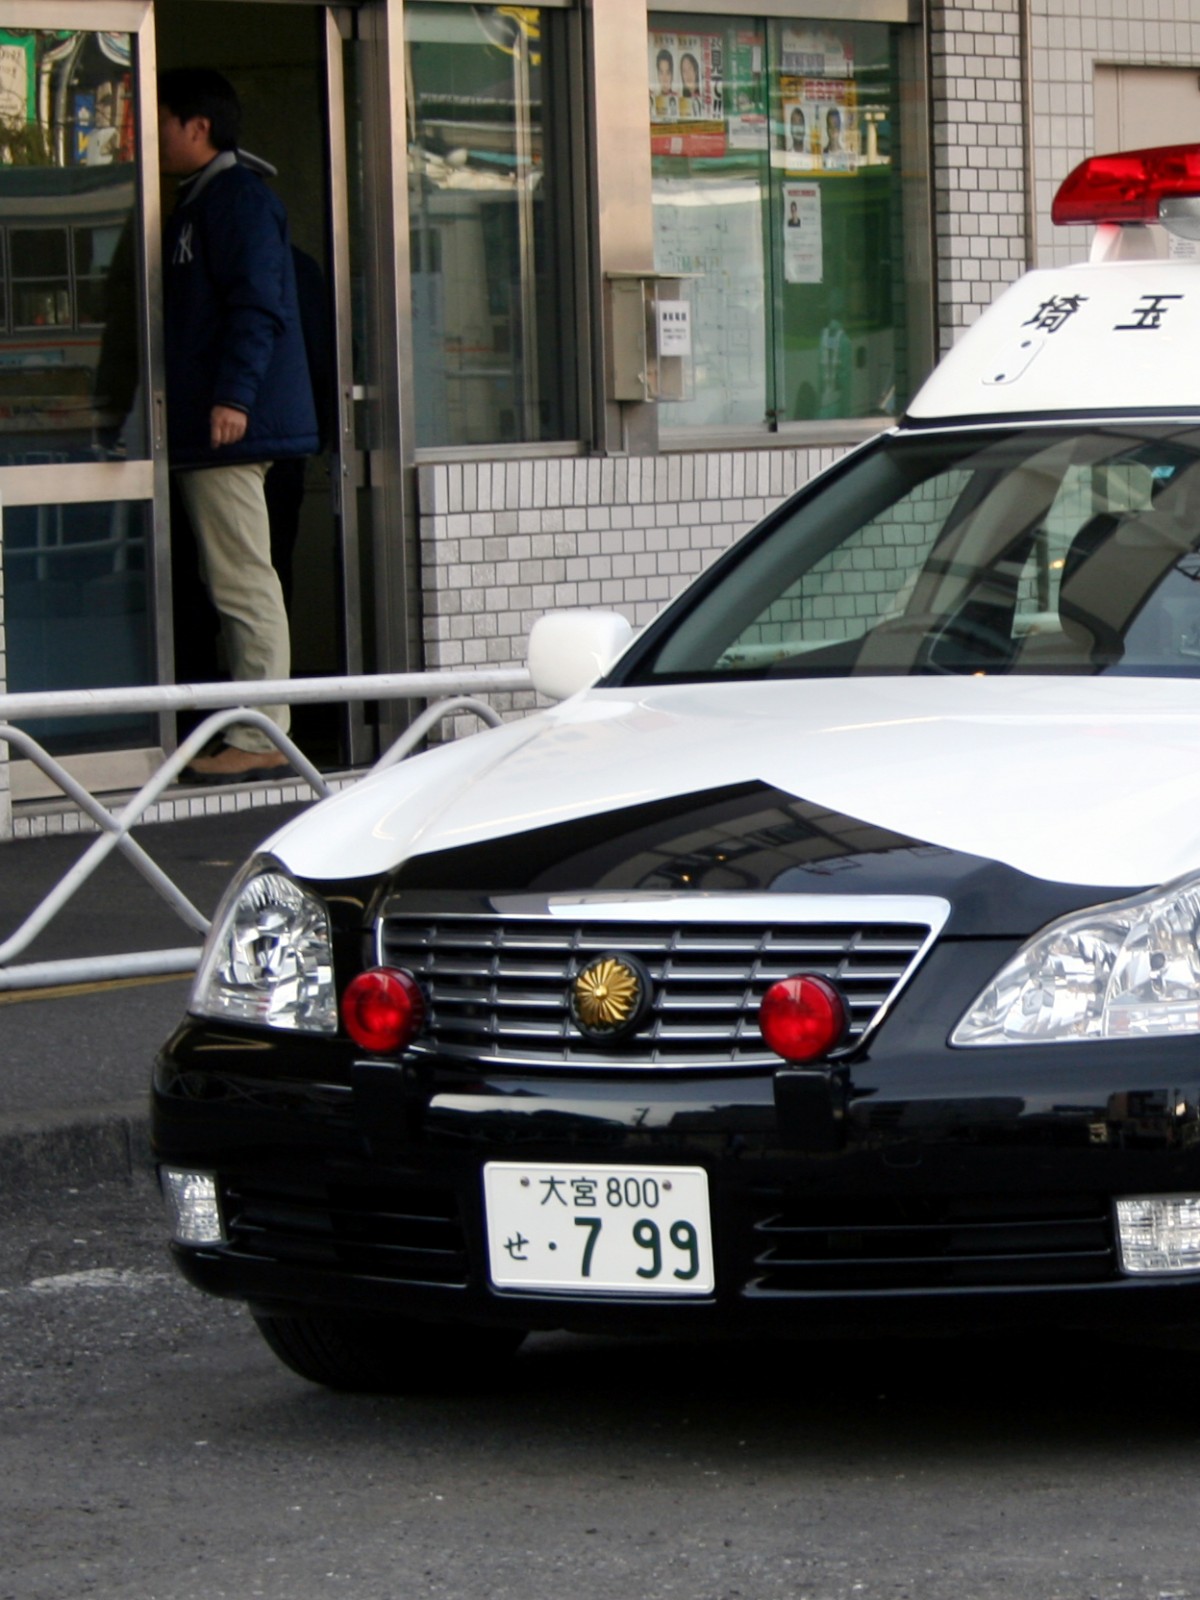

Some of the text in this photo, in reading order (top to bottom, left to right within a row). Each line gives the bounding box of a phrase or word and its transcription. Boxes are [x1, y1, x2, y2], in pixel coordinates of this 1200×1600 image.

[539, 1175, 660, 1208] 大宮 800
[503, 1231, 530, 1261] せ
